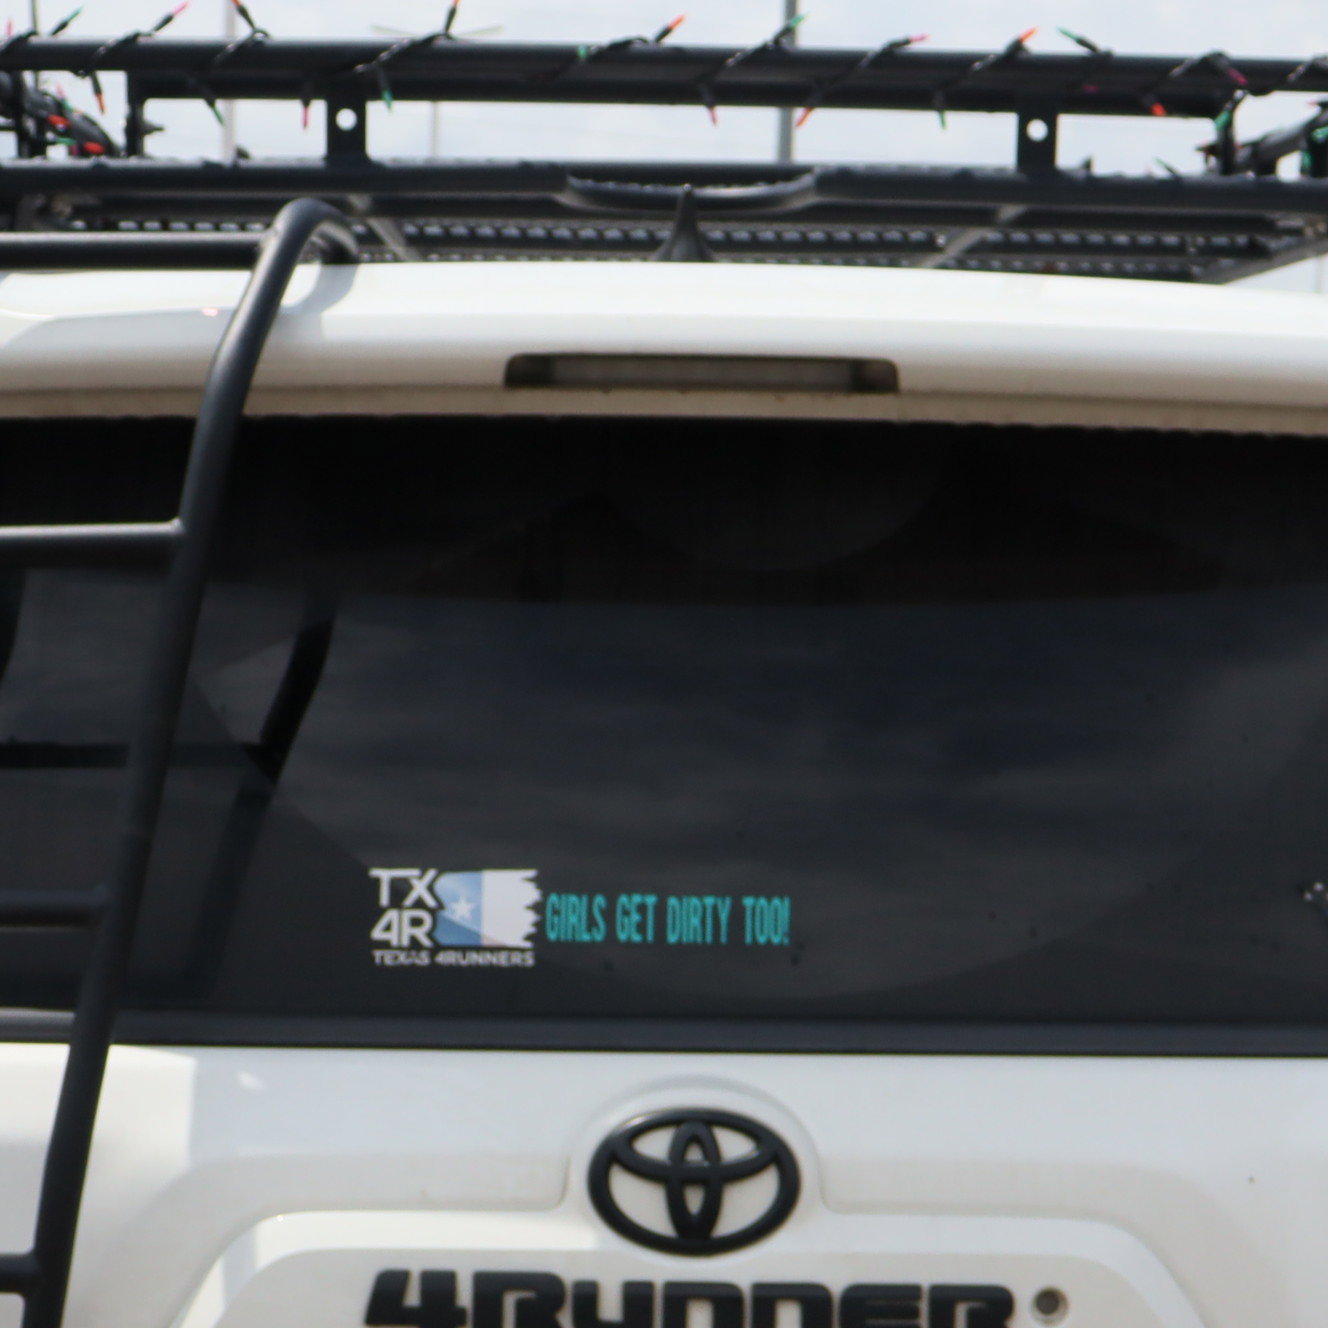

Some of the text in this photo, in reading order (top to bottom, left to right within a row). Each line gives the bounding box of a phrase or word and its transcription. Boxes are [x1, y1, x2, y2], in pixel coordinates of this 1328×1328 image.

[369, 868, 438, 908] TX
[370, 908, 435, 948] 4R
[545, 893, 791, 946] GIRLS GET DIRTY TOO!
[373, 950, 536, 968] TEXAS 4RUNNERS
